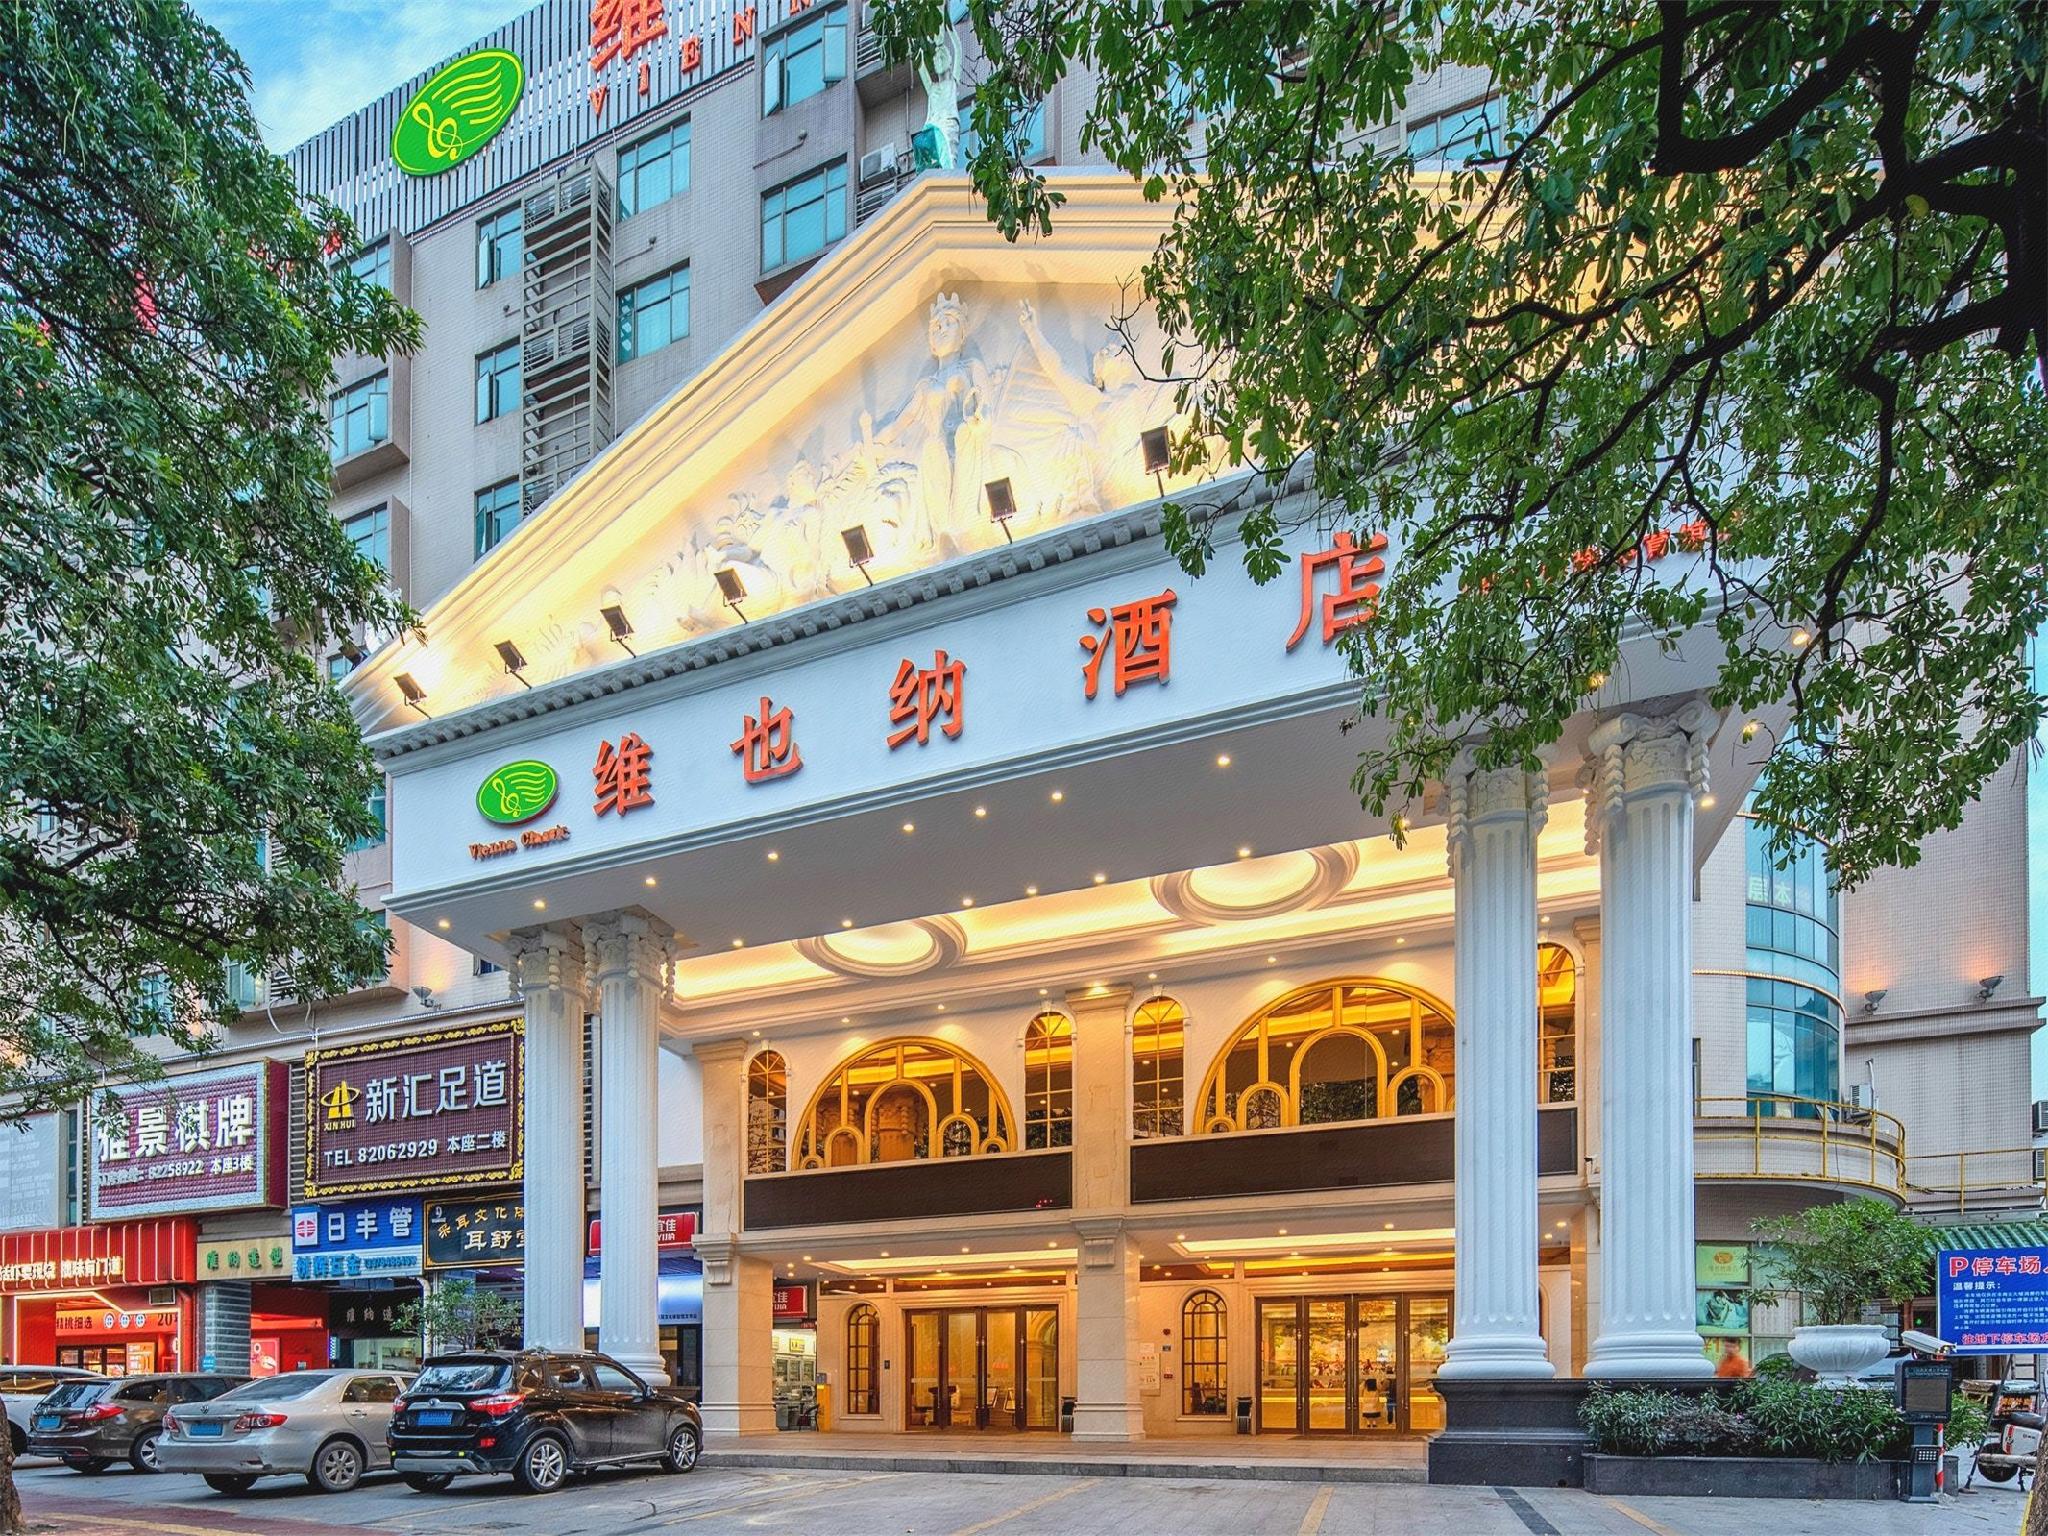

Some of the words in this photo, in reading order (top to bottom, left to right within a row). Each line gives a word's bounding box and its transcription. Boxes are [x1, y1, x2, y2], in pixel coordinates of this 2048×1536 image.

[592, 528, 1387, 818] 维也纳酒店
[469, 839, 518, 860] Vienna
[365, 1059, 507, 1124] 新汇足道
[99, 1094, 256, 1163] 雅景棋牌
[324, 1121, 338, 1131] XIN
[340, 1119, 355, 1129] HUI
[210, 1154, 254, 1176] 本座3楼
[324, 1149, 353, 1168] TEL
[358, 1139, 438, 1163] 82062929
[447, 1130, 507, 1154] 本座二楼
[328, 1206, 413, 1242] 日丰管
